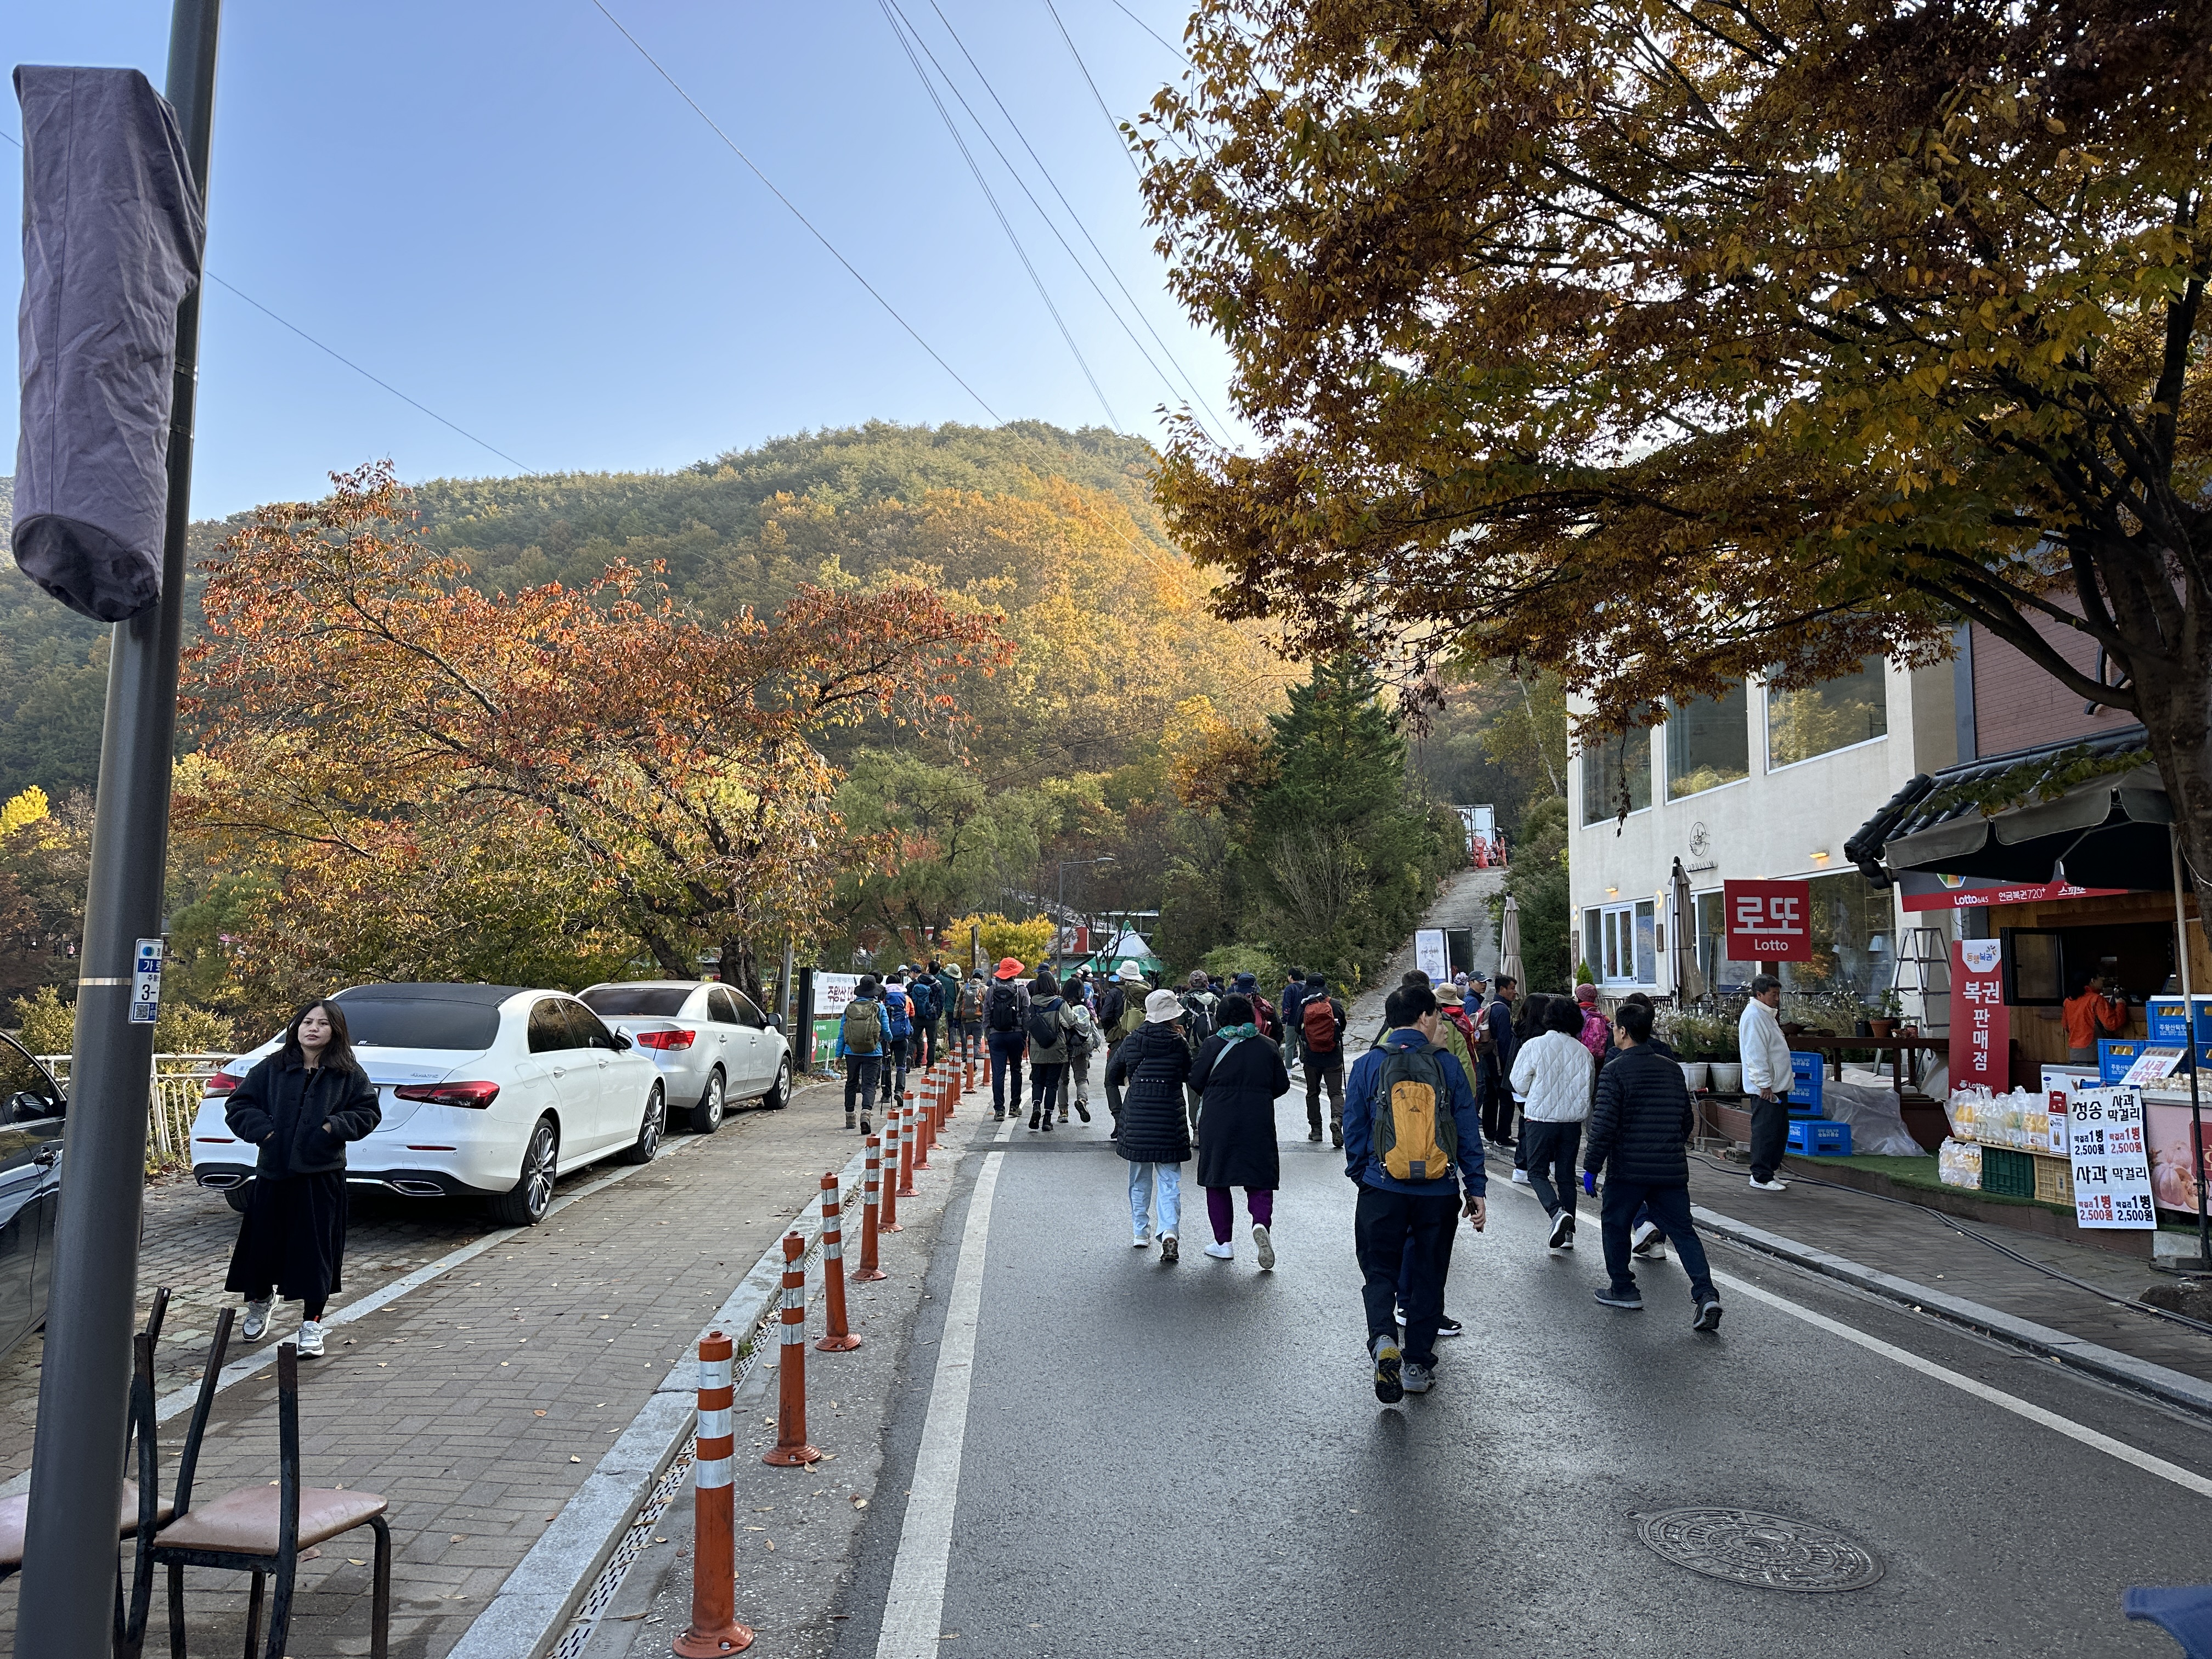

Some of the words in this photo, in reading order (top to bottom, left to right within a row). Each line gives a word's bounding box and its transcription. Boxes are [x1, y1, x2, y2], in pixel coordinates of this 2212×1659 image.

[1733, 896, 1803, 934] 로또
[1754, 939, 1788, 951] Lotto
[1967, 952, 1993, 964] 동행복권
[141, 984, 159, 1001] 3-
[827, 985, 847, 1002] 주왕산
[1963, 980, 2000, 1005] 복권
[1972, 1008, 1990, 1071] 판매점
[2141, 1060, 2168, 1071] 사과
[2112, 1094, 2135, 1108] 사과
[2072, 1101, 2102, 1121] 청송
[2108, 1107, 2140, 1122] 막걸리
[2074, 1135, 2089, 1143] 막걸리
[2109, 1133, 2125, 1142] 막걸리
[2075, 1143, 2104, 1156] 2,500원
[2111, 1142, 2142, 1155] 2,500원
[2076, 1165, 2107, 1184] 사과
[2112, 1167, 2147, 1181] 막걸리
[2080, 1209, 2113, 1222] 2,500원
[2118, 1209, 2154, 1222] 2,500원
